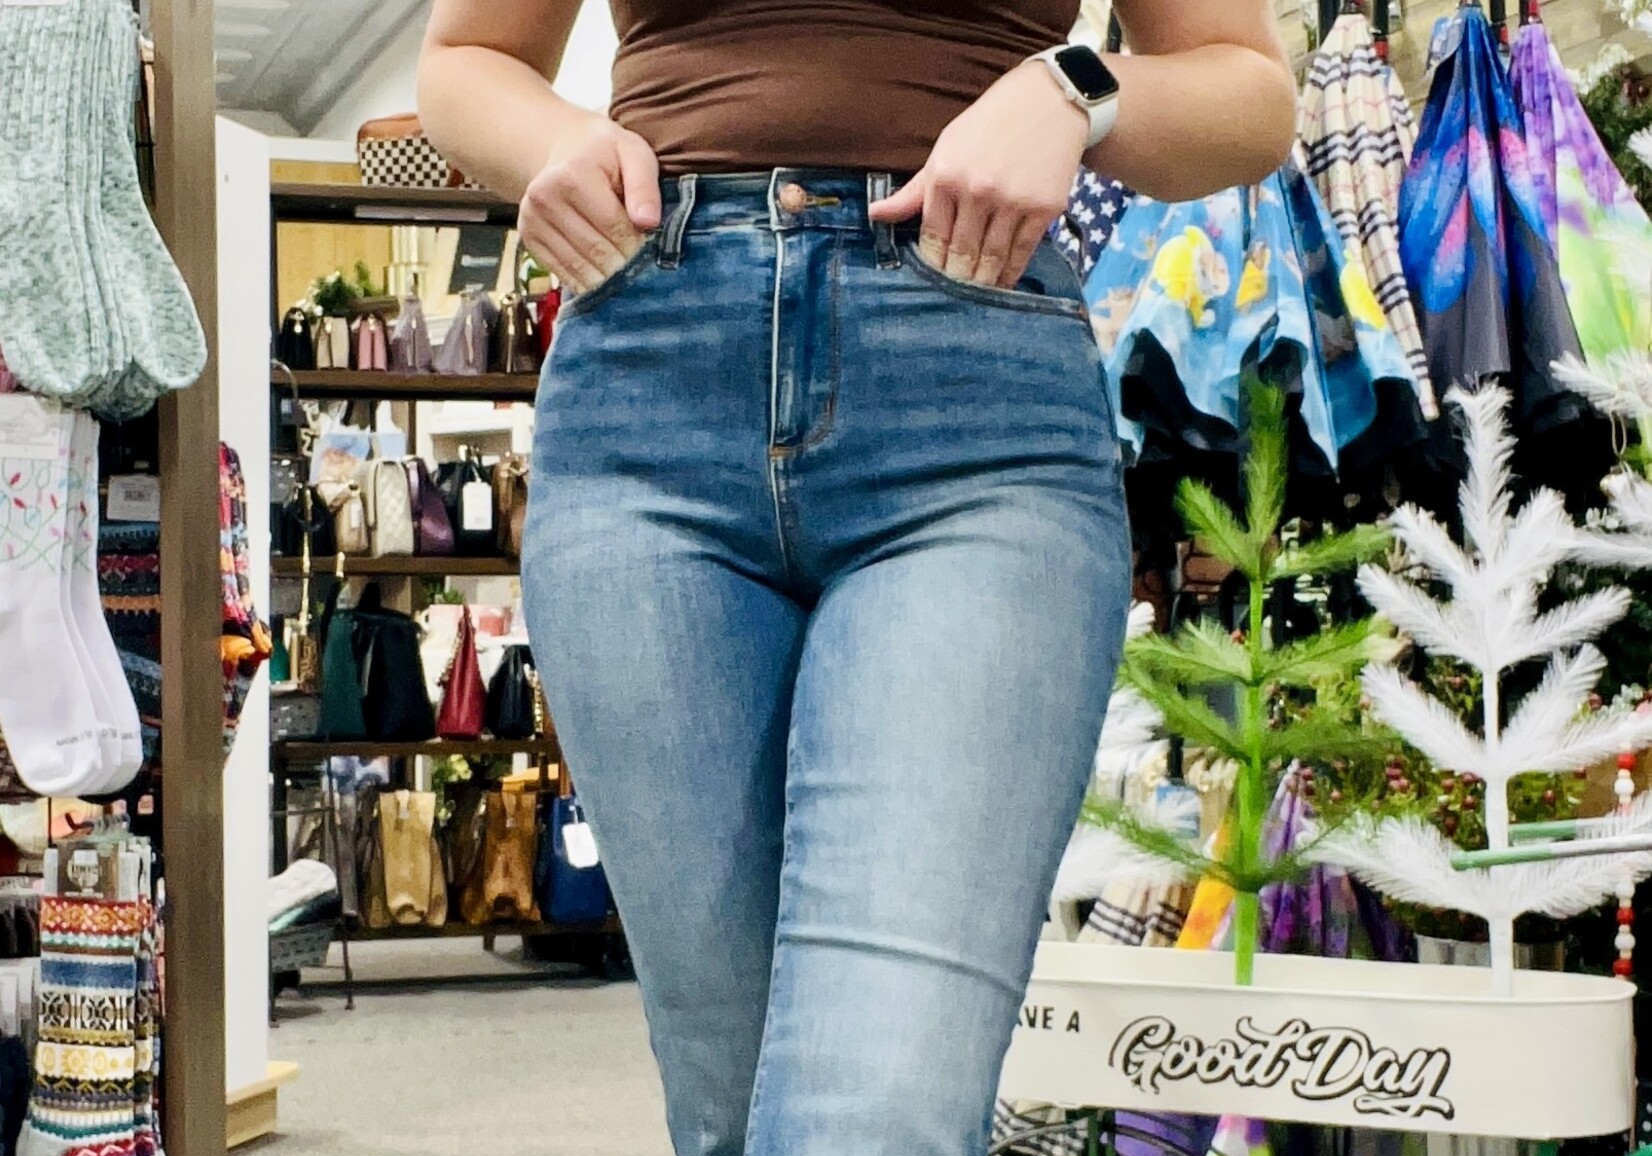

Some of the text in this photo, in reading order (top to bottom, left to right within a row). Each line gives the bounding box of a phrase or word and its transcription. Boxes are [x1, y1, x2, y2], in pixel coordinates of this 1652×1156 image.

[1018, 1005, 1455, 1121] VE A Good Day
